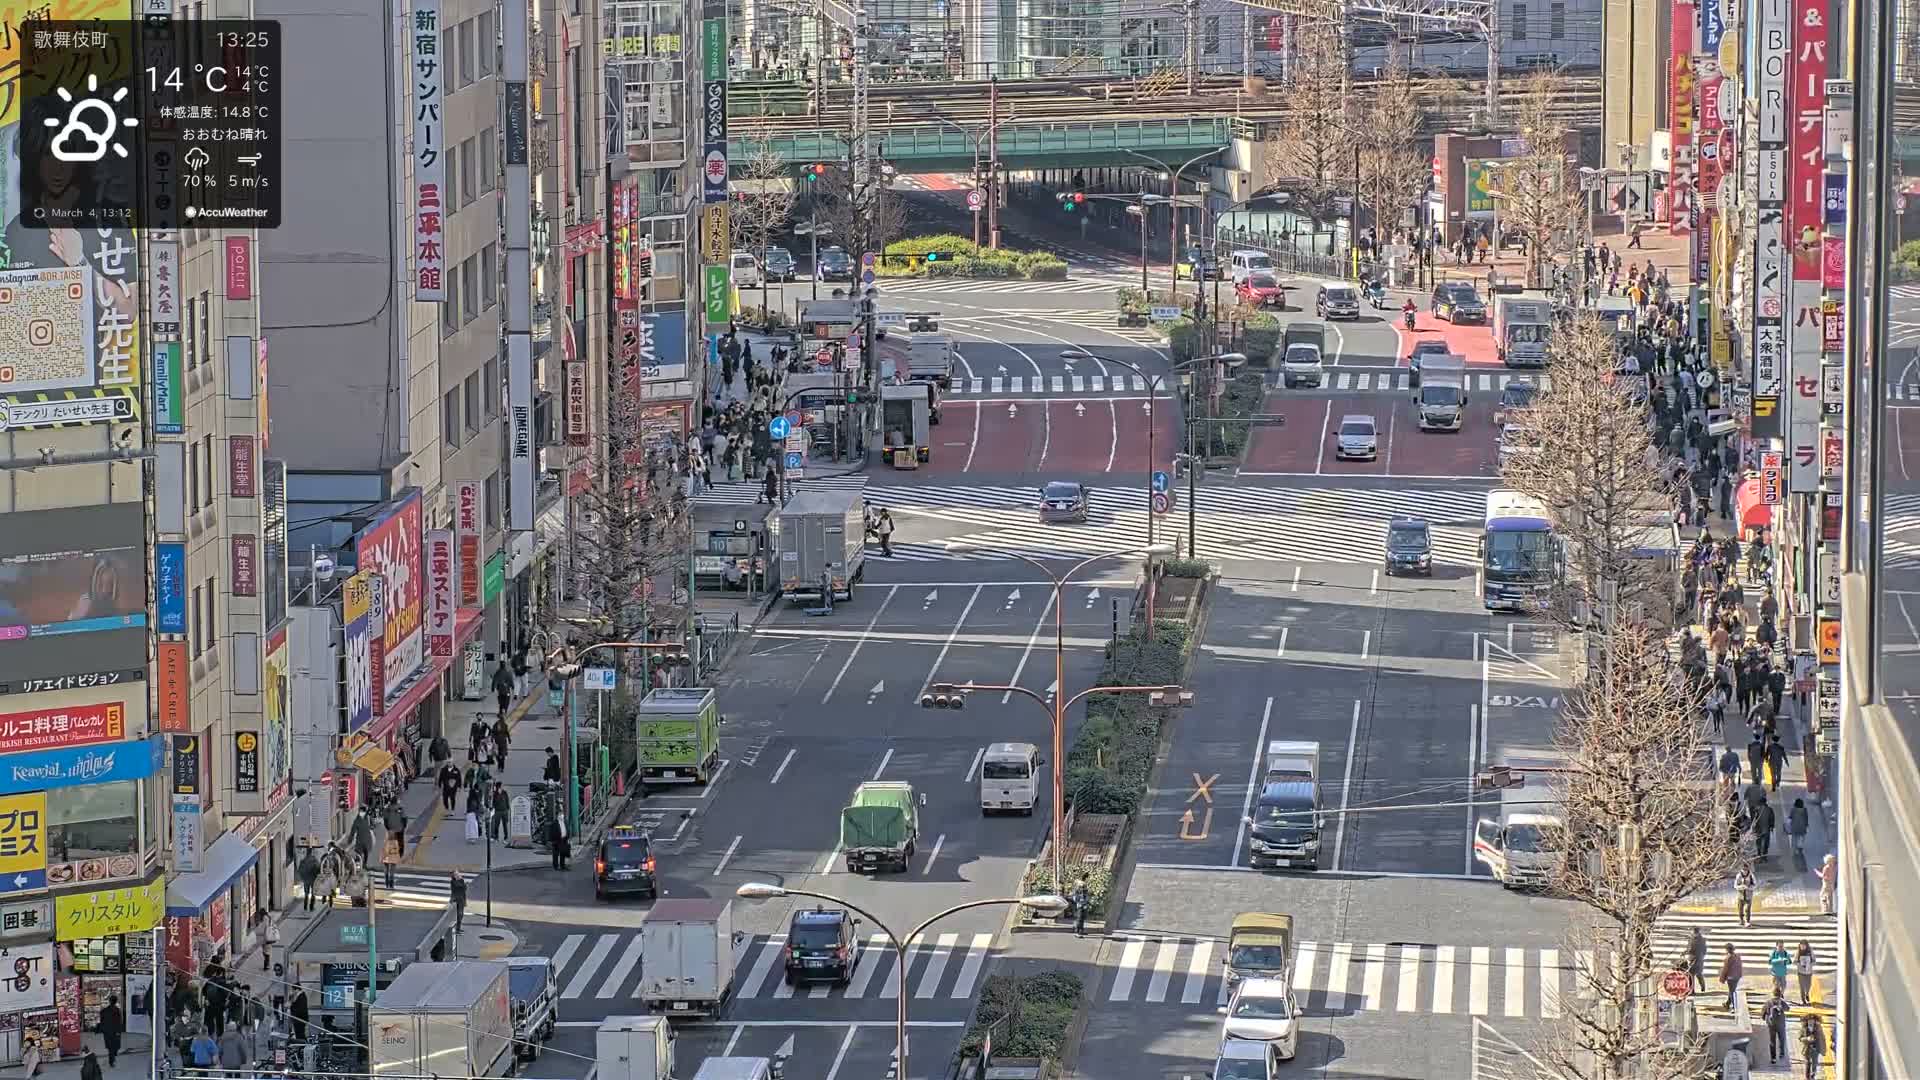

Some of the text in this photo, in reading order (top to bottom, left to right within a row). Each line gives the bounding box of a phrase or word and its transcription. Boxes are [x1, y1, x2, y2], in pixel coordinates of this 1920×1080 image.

[1706, 86, 1717, 118] アコム
[416, 10, 441, 290] 新宿サンパーク 三平本館
[708, 159, 725, 176] 薬
[710, 207, 723, 262] 肉汁水餃子
[709, 274, 724, 313] レイク
[157, 323, 175, 331] 3F
[1760, 328, 1773, 381] 大衆酒場
[155, 352, 169, 413] FamilyMart
[1795, 306, 1819, 467] パセラ
[13, 403, 111, 420] テンクリ たいせい先生
[514, 405, 528, 459] HOMEGAME
[461, 486, 471, 529] GAME
[713, 539, 725, 550] 10
[161, 553, 172, 604] ゲウチャイ
[373, 576, 383, 618] 389
[24, 671, 119, 693] リアエイド ビジョン
[109, 710, 118, 733] 5F
[24, 734, 69, 746] RESTAURANT
[0, 811, 38, 831] プロ
[1, 836, 39, 856] ミス
[3, 910, 38, 931] 囲碁
[69, 902, 141, 926] クリスタル
[328, 990, 342, 1003] 12
[382, 1037, 406, 1045] SEINO
